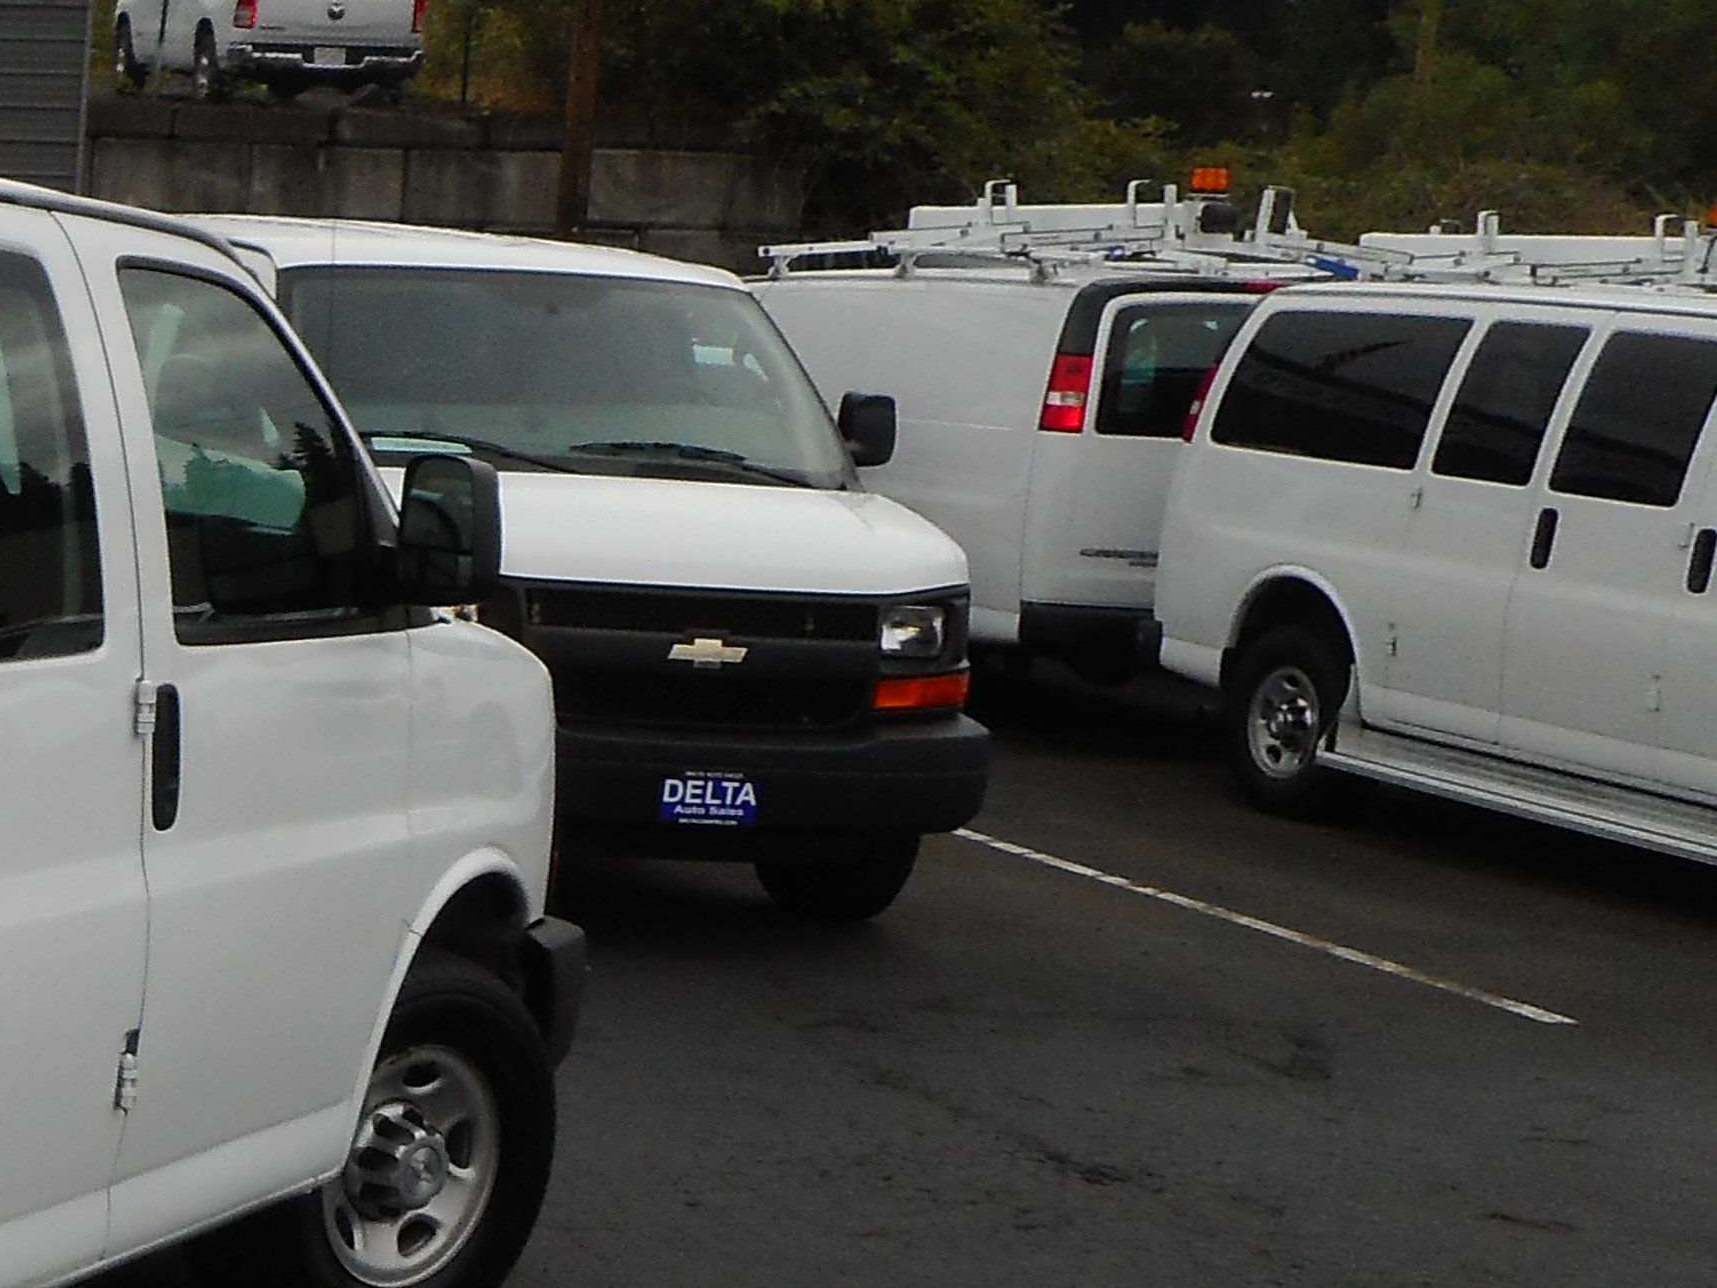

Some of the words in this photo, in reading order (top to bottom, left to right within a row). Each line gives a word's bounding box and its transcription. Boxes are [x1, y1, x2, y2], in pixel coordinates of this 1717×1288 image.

[663, 778, 757, 807] DELTA
[674, 804, 706, 815] Auto
[708, 806, 745, 816] Sales
